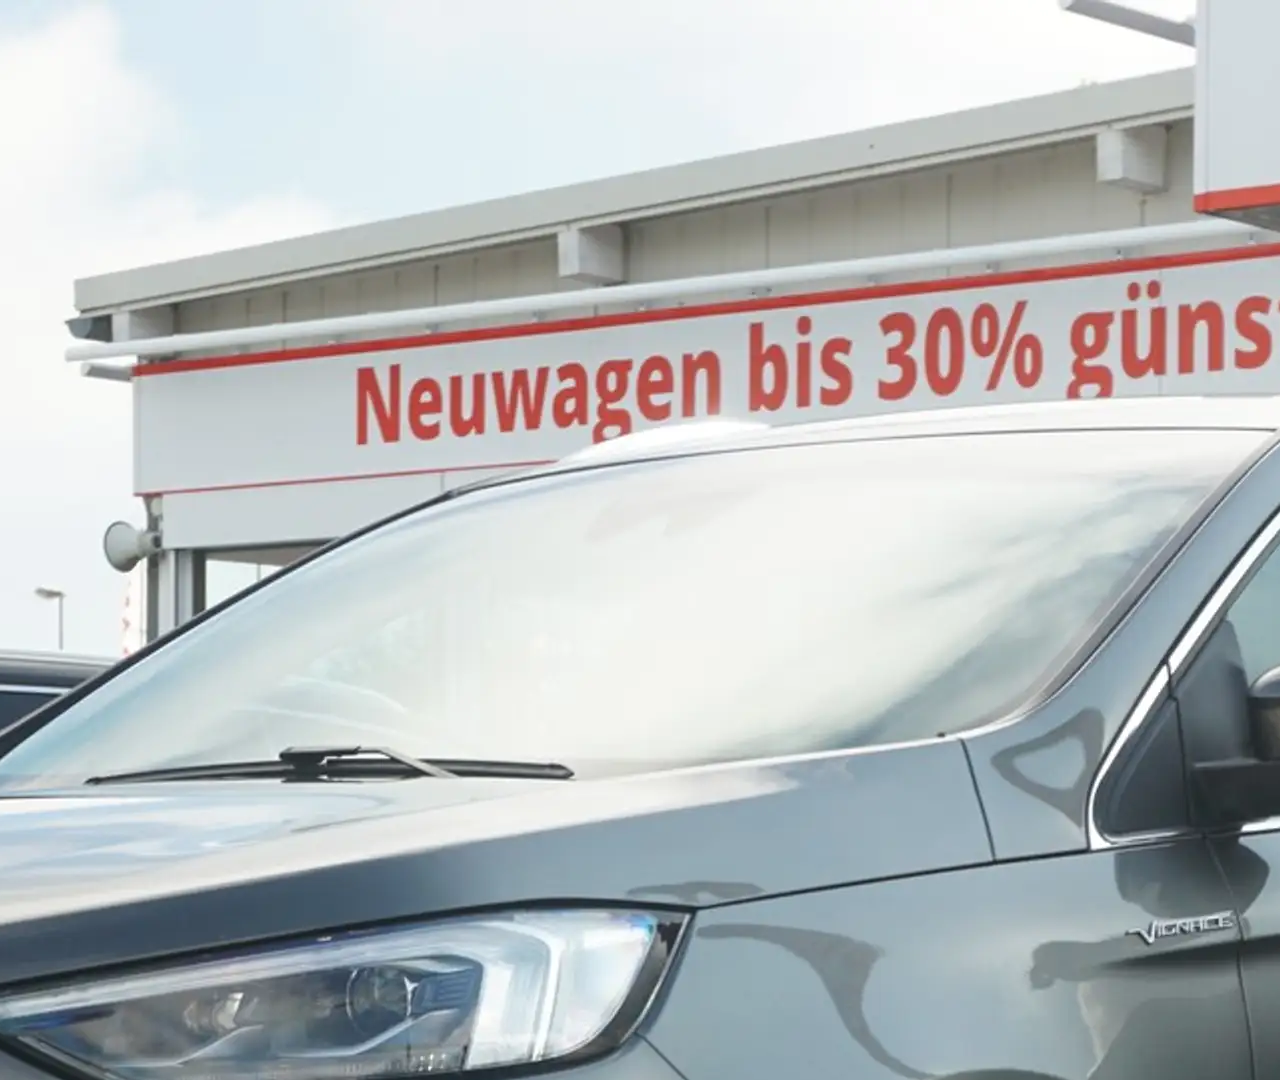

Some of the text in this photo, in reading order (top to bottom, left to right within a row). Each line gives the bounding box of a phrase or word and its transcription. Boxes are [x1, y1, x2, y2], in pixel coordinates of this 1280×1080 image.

[355, 350, 721, 445] Neuwagen
[748, 316, 853, 412] bis
[877, 300, 1043, 400] 30%
